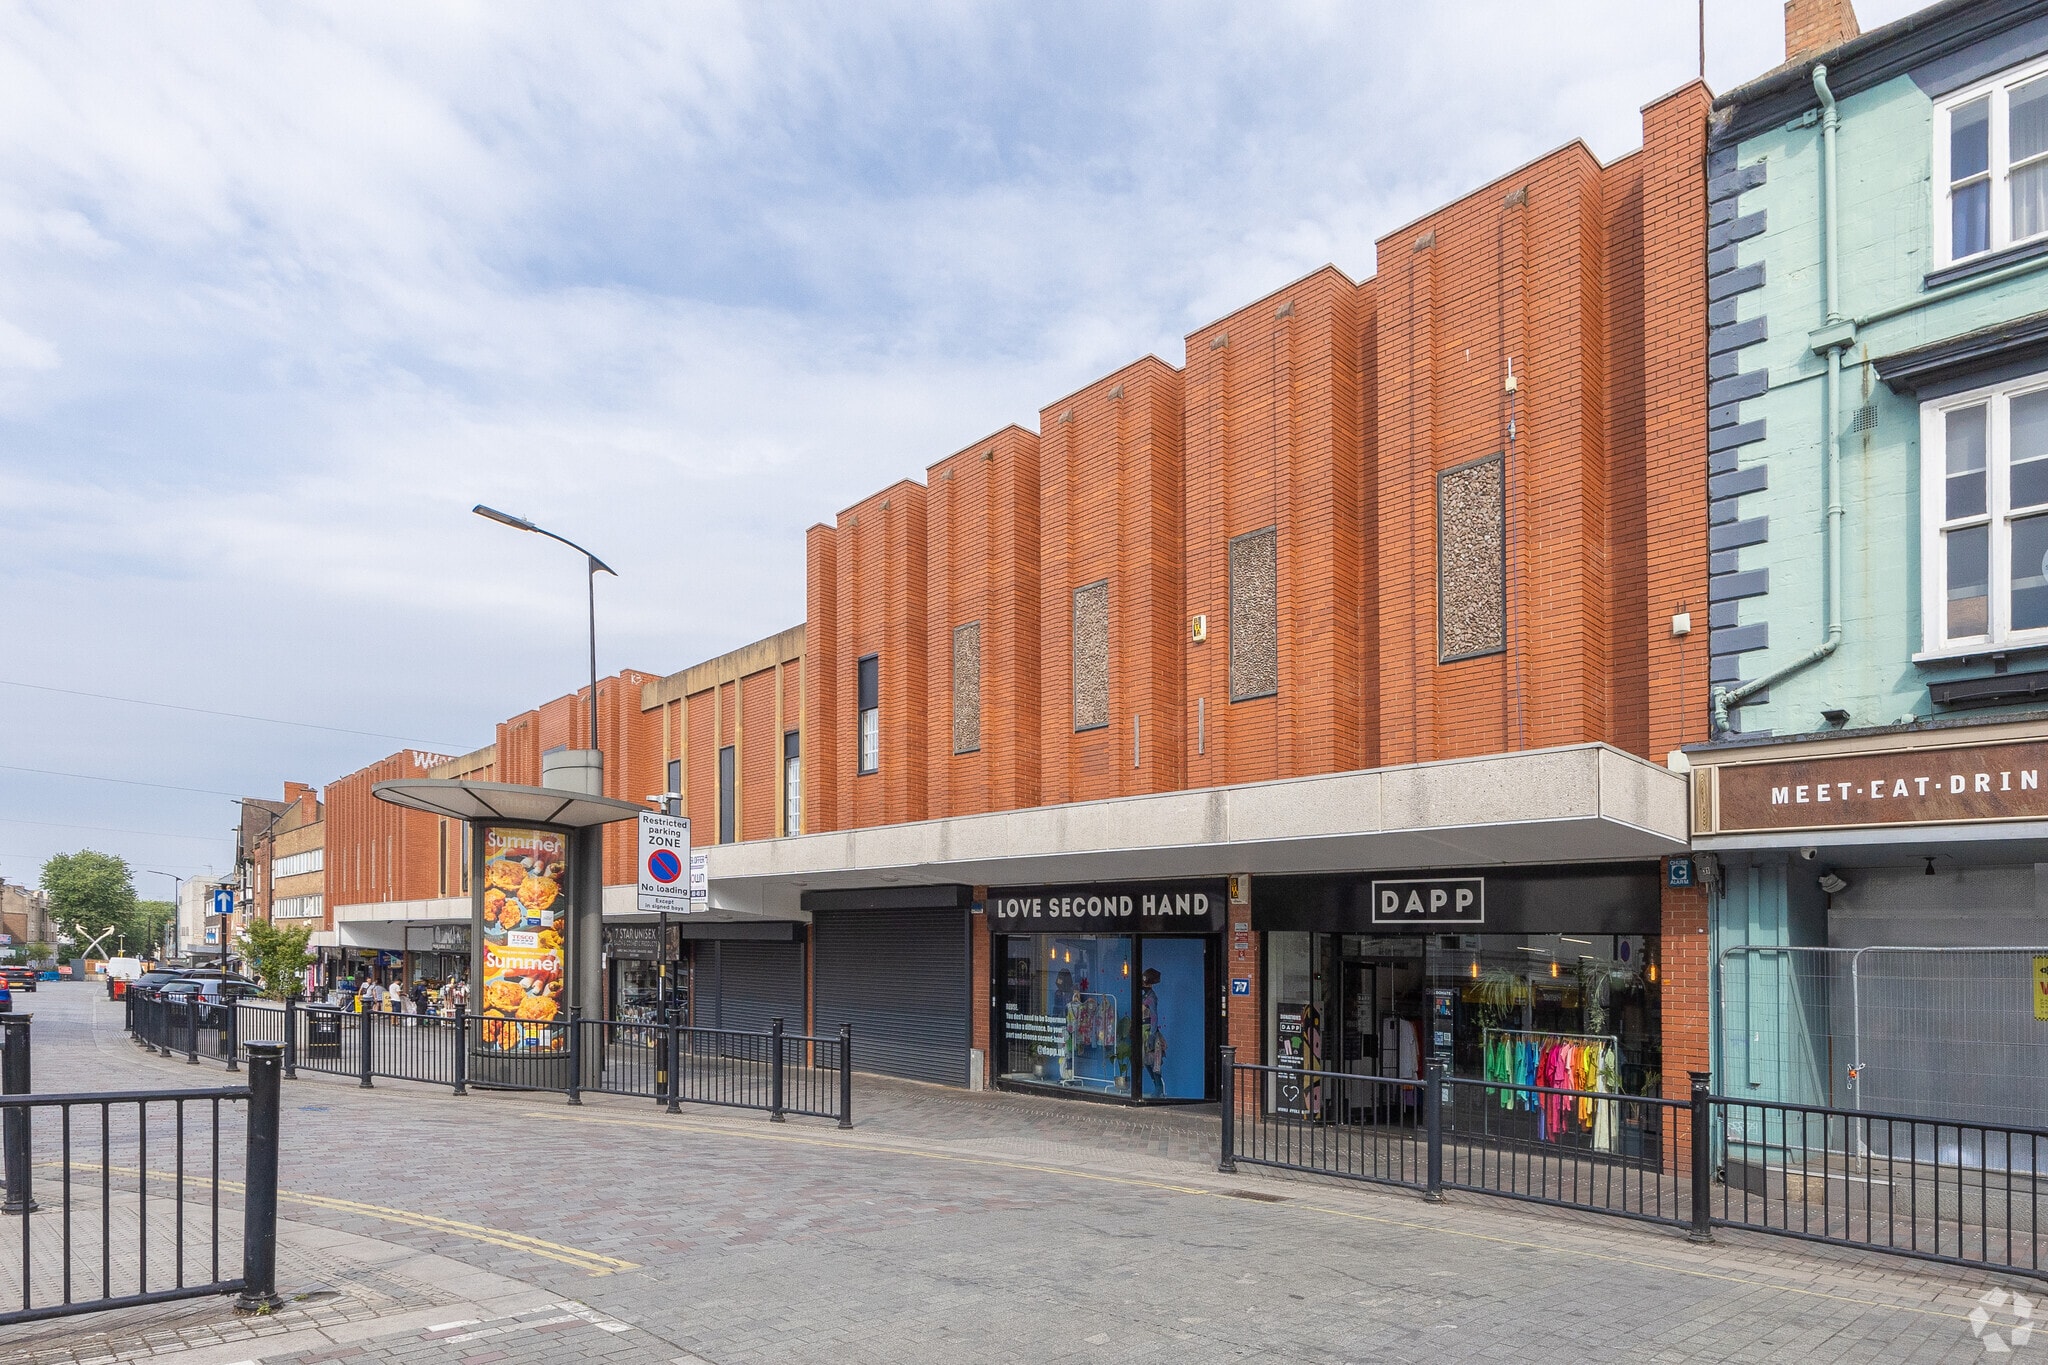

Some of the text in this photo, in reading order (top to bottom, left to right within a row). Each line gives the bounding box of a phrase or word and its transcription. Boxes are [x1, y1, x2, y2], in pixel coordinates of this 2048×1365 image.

[1771, 770, 2038, 805] MEET EAT DRIN
[642, 816, 687, 829] Restricted
[648, 827, 681, 838] parking
[648, 836, 681, 848] ZONE
[641, 883, 688, 896] No loading
[655, 897, 674, 905] Except
[997, 893, 1209, 918] LOVE SECOND HAND
[1381, 888, 1474, 914] DAPP
[615, 928, 656, 940] 7 STAR UNISEX
